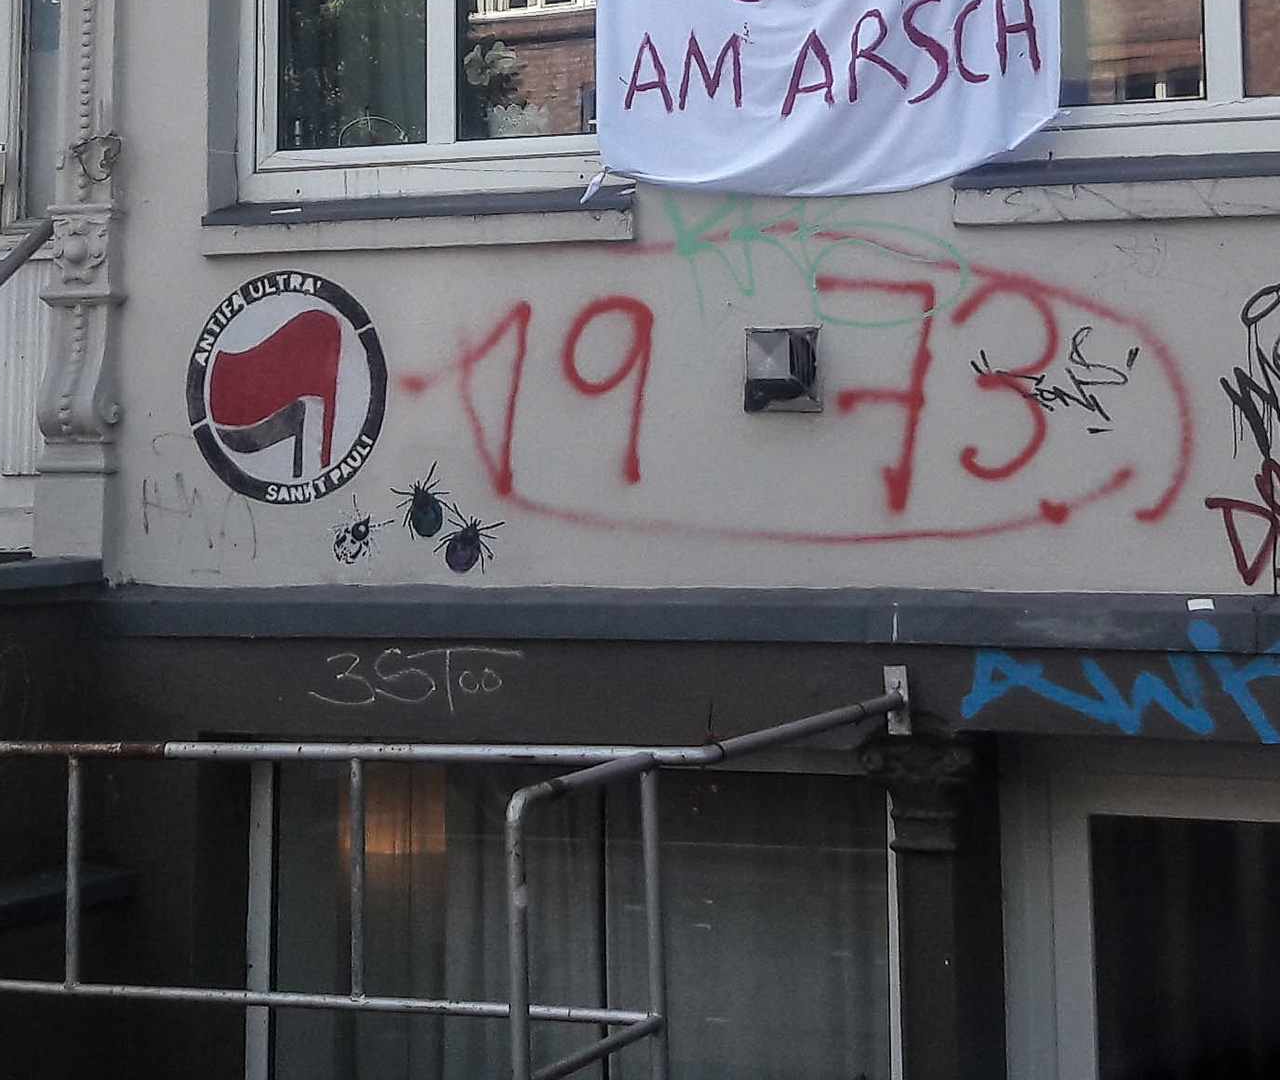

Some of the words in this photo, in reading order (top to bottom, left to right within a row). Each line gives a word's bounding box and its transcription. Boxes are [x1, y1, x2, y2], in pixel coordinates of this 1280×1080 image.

[624, 29, 743, 113] AM
[193, 290, 247, 366] ANTIFA
[330, 435, 374, 485] PAULI
